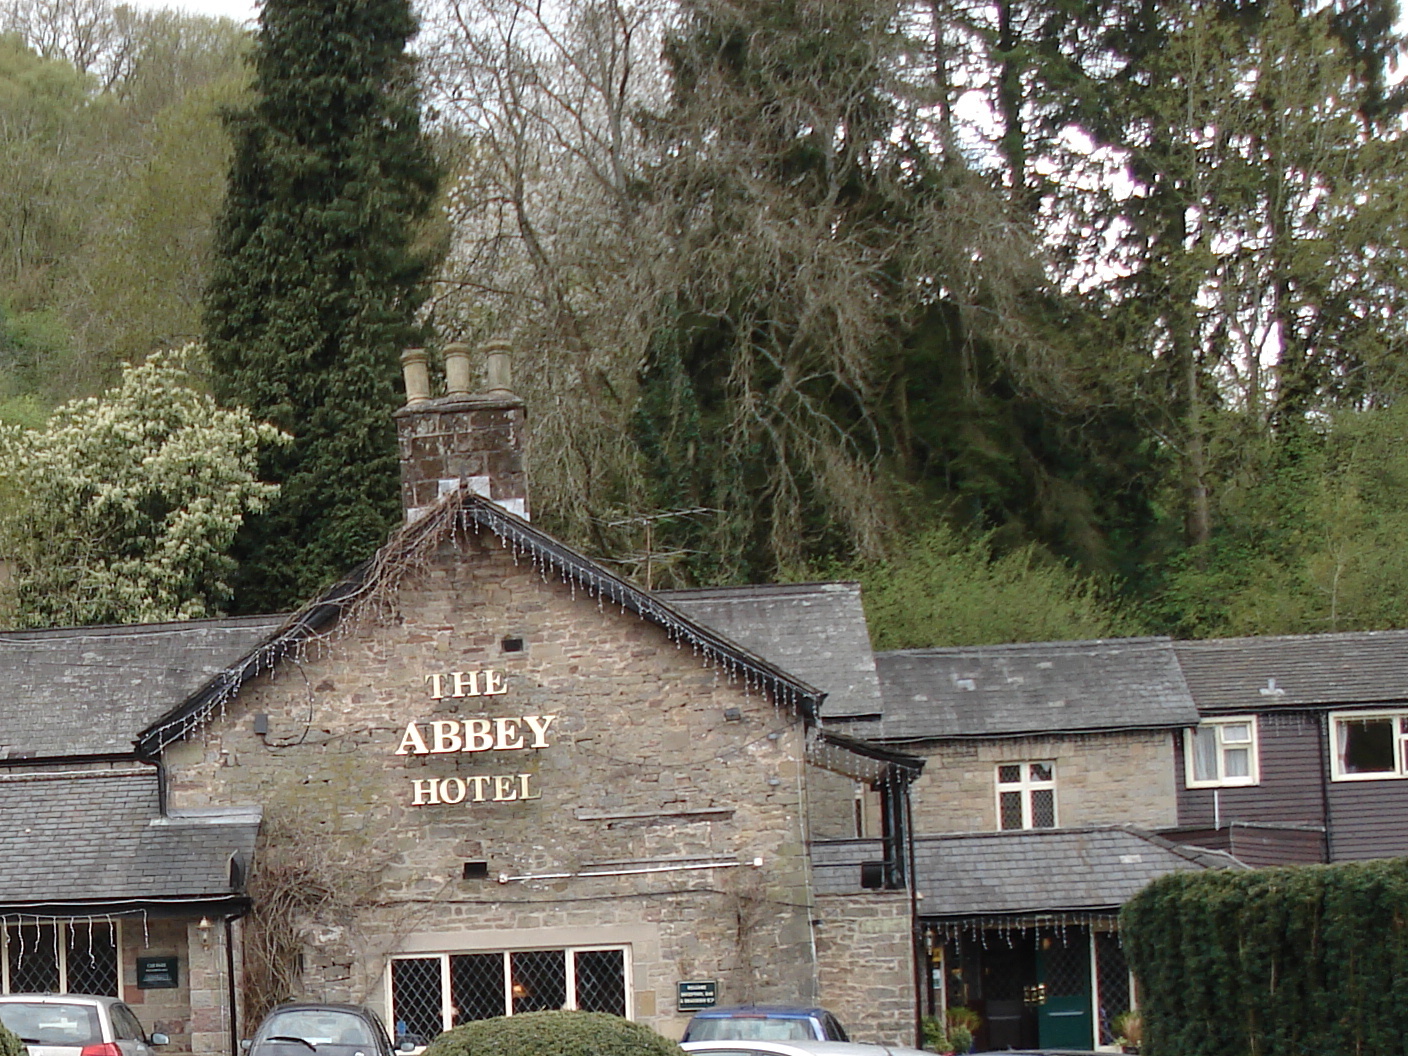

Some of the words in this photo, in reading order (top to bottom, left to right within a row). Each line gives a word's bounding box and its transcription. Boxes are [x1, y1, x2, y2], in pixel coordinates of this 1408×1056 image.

[424, 669, 508, 700] THE
[395, 715, 556, 755] ABBEY
[410, 773, 542, 806] HOTEL
